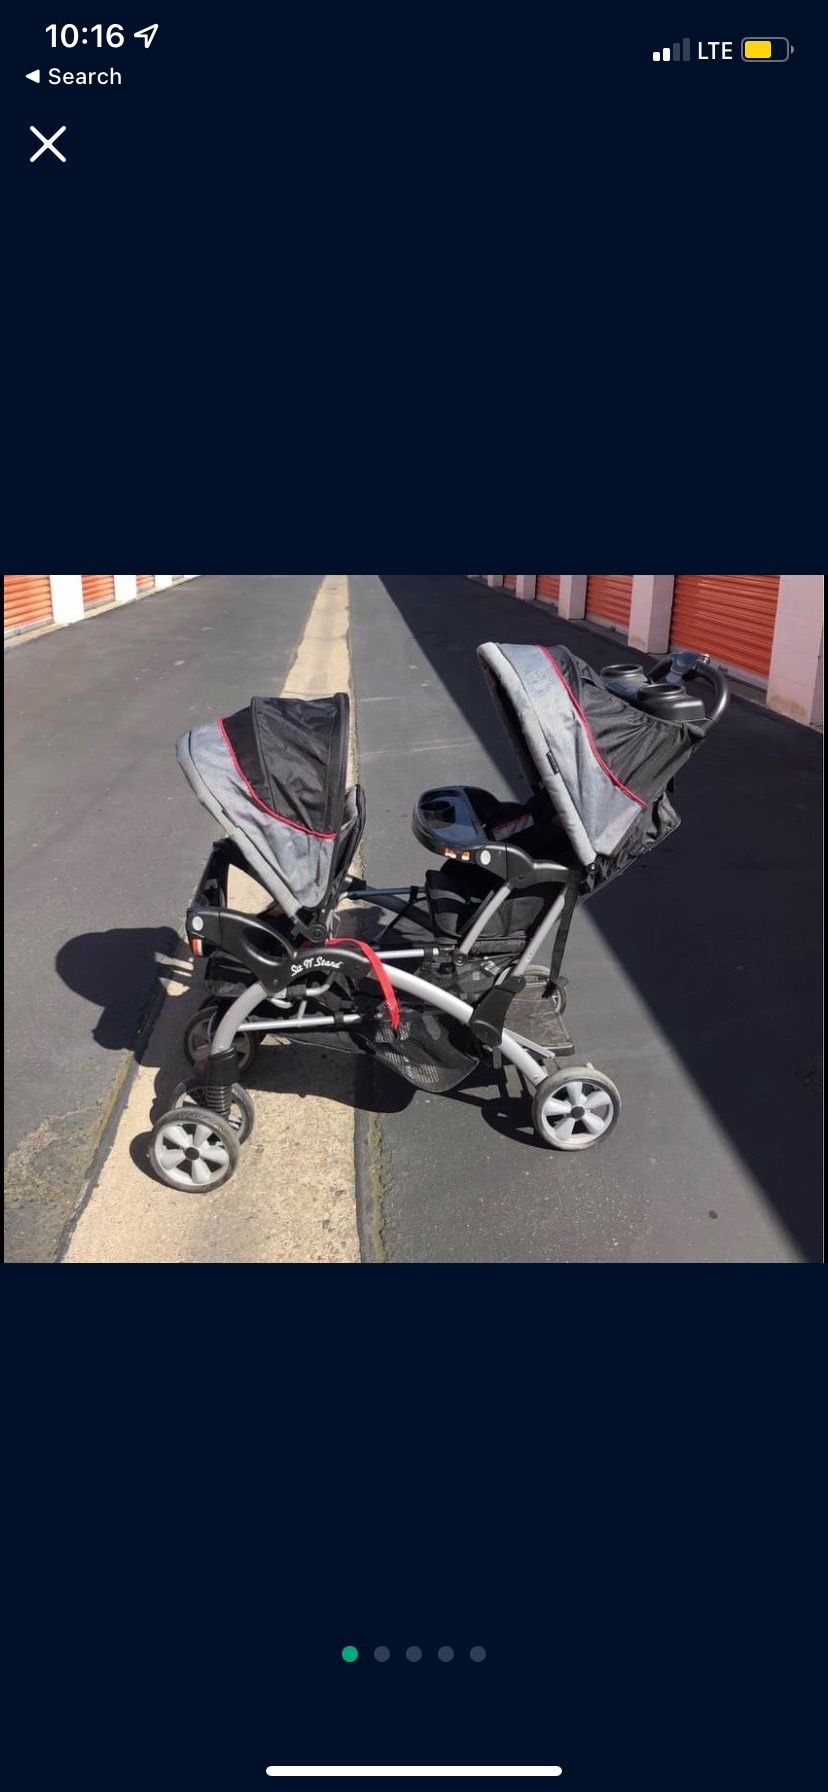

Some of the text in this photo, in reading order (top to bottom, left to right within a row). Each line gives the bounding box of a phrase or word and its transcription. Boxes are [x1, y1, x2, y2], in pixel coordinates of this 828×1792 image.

[45, 23, 125, 49] 10:16
[698, 41, 733, 60] LTE
[48, 67, 122, 86] Search
